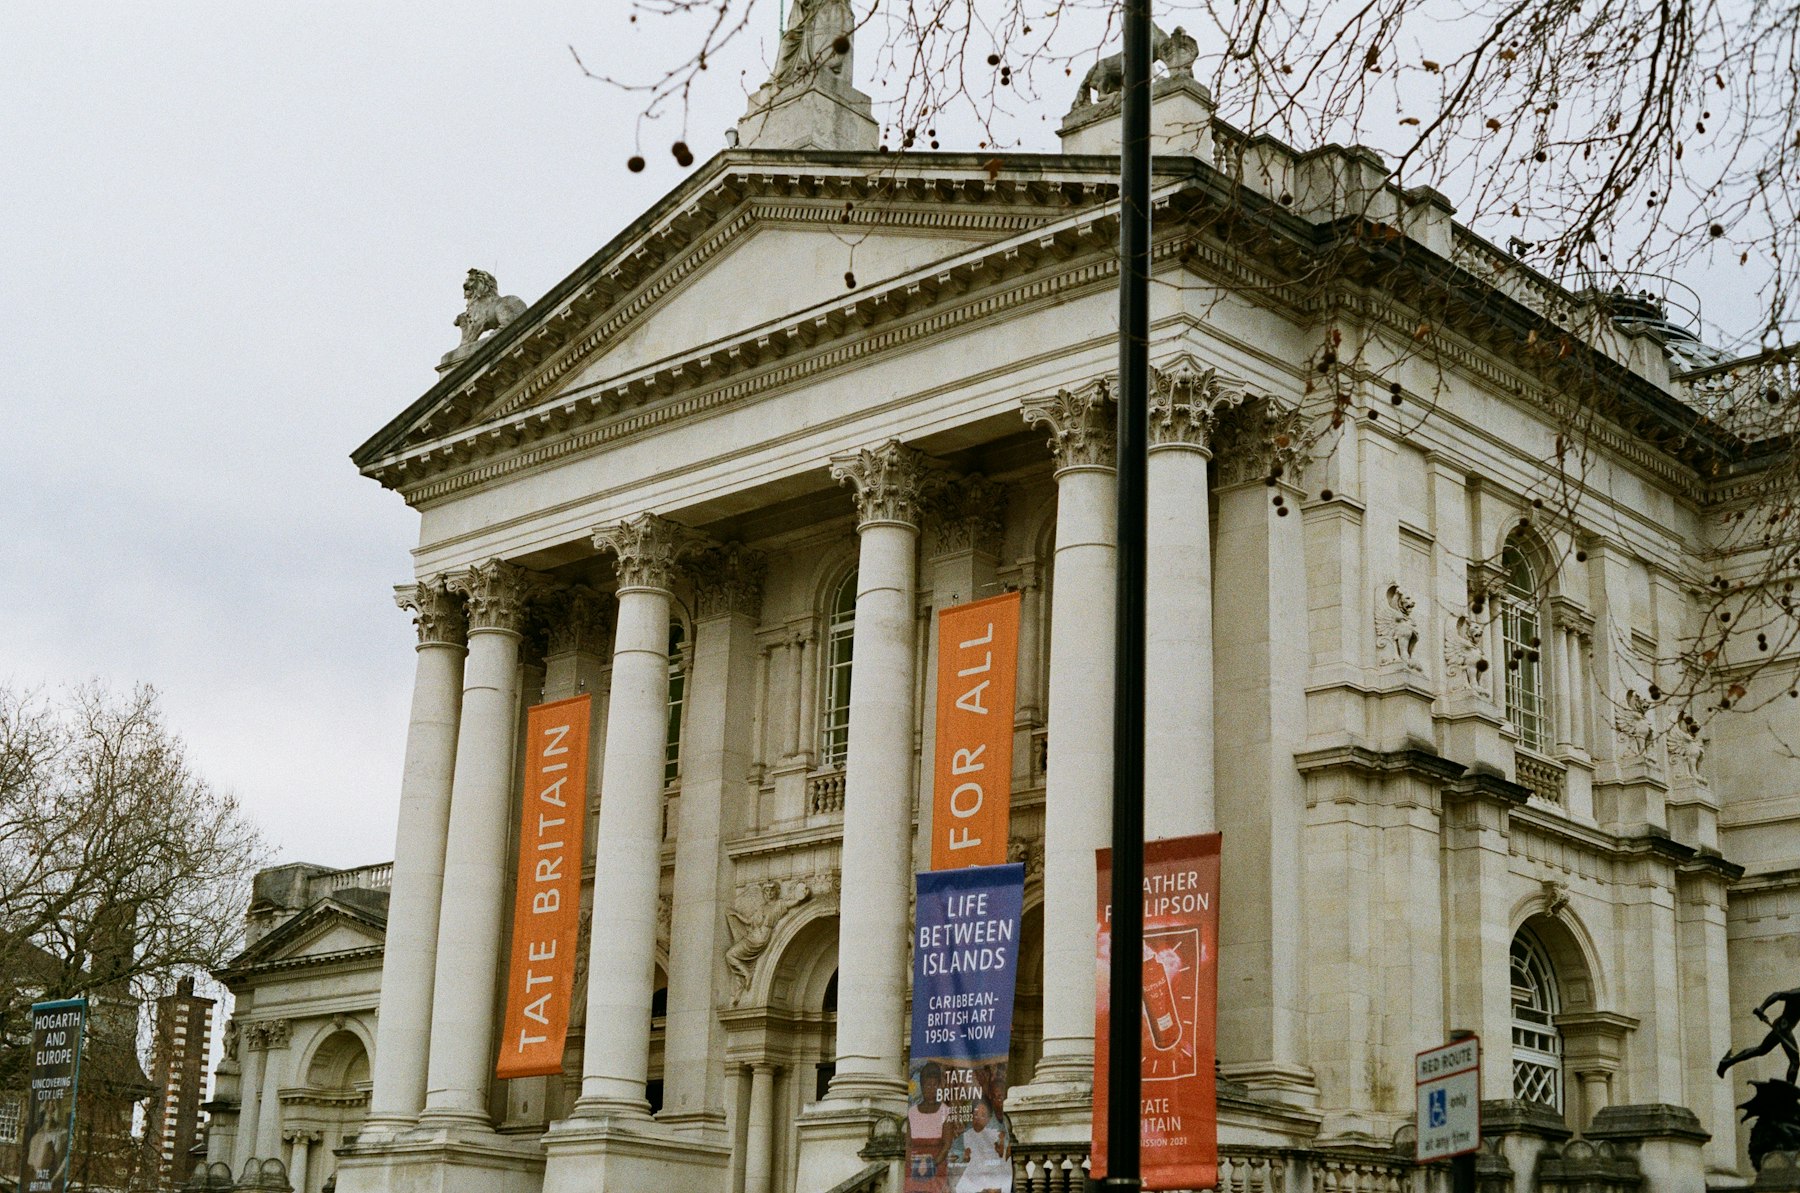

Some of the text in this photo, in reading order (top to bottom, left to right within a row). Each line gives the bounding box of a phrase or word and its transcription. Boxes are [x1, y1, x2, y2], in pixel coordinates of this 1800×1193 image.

[950, 623, 993, 850] FOR ALL
[518, 724, 570, 1053] TATE BRITAIN
[1142, 871, 1198, 894] ATHER
[947, 893, 987, 917] LIFE
[919, 918, 1013, 948] BETWEEN
[923, 947, 1006, 976] ISLANDS
[929, 991, 999, 1010] CARIBBEAN-
[34, 1012, 80, 1030] HOGARTH
[928, 1009, 995, 1027] BRITISH ART
[45, 1031, 66, 1047] AND
[925, 1029, 956, 1043] 1950s
[36, 1049, 72, 1066] EUROPE
[1422, 1047, 1472, 1074] RED ROUTE
[32, 1076, 71, 1089] UNCOVERING
[945, 1069, 973, 1084] TATE
[38, 1088, 64, 1101] CITY LIFE
[936, 1086, 982, 1102] BRITAIN
[1170, 1137, 1187, 1146] 2021
